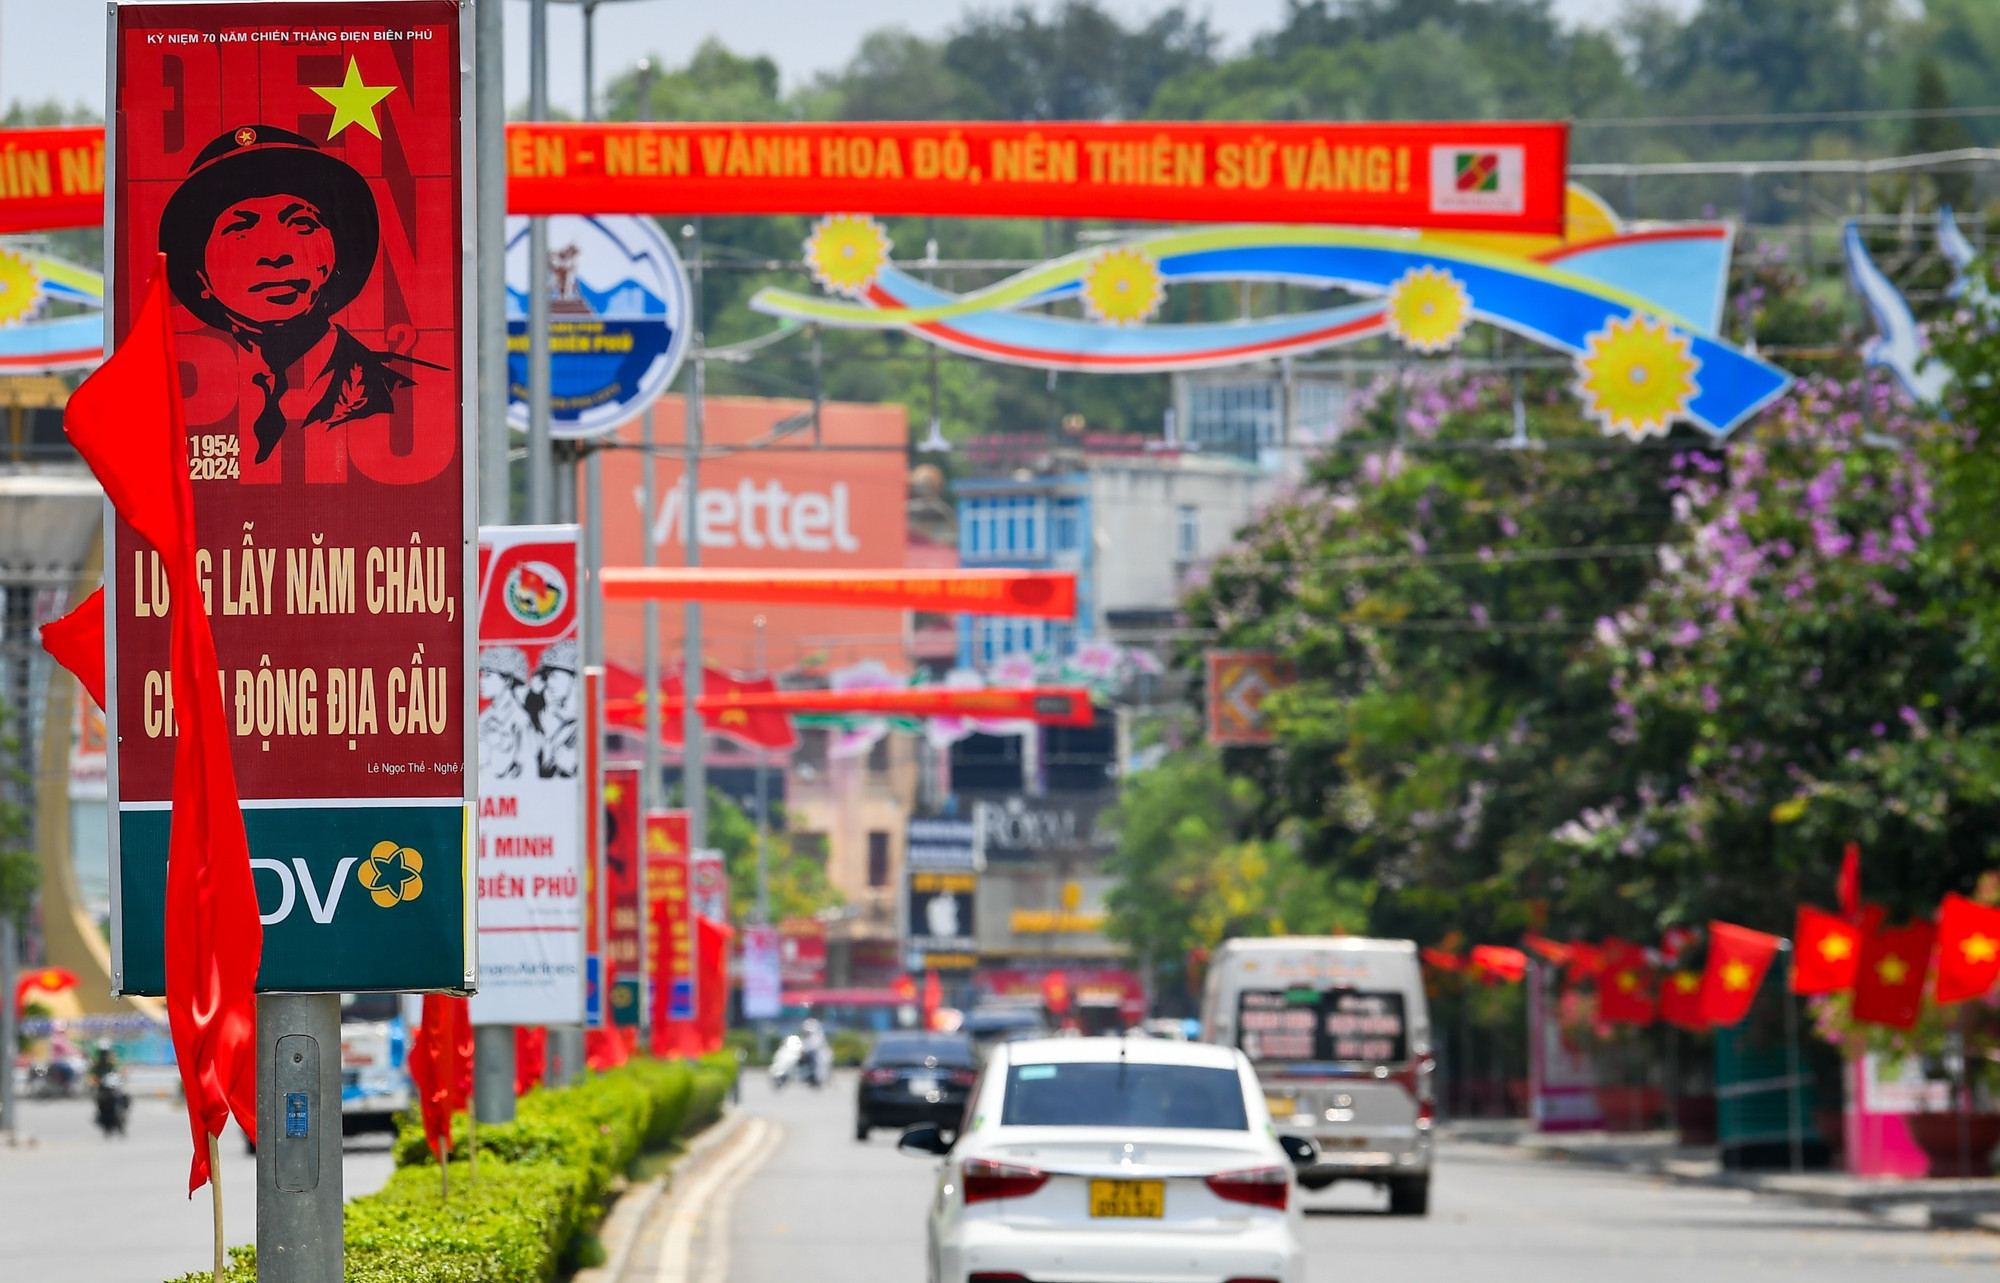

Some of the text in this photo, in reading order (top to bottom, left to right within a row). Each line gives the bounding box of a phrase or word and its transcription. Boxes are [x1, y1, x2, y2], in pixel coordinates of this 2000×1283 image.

[168, 34, 198, 45] NIỆM
[202, 34, 216, 43] 70
[219, 31, 247, 42] NĂM
[250, 29, 289, 41] CHIẾN
[340, 31, 370, 43] ĐIỆN
[373, 29, 403, 40] BIÊN
[406, 29, 433, 40] PHỦ
[0, 141, 52, 198] ÍN
[508, 130, 566, 176] ÊN
[604, 130, 690, 177] NÊN
[700, 130, 810, 178] VÀNH
[821, 137, 904, 179] HOA
[913, 130, 982, 186] ĐỎ,
[990, 132, 1079, 183] NÊN
[1085, 134, 1206, 187] THIÊN
[190, 434, 240, 457] 1954
[189, 457, 240, 480] 2024
[286, 533, 355, 615] NĂM
[366, 531, 455, 622] CHÂU,
[235, 653, 318, 752] ĐỘNG
[327, 667, 379, 751] ĐỊA
[387, 642, 448, 737] CẦU
[367, 763, 379, 773] Lê
[382, 763, 406, 775] Ngọc
[434, 762, 459, 775] Nghệ
[495, 837, 554, 857] MINH
[533, 868, 578, 898] PHỦ
